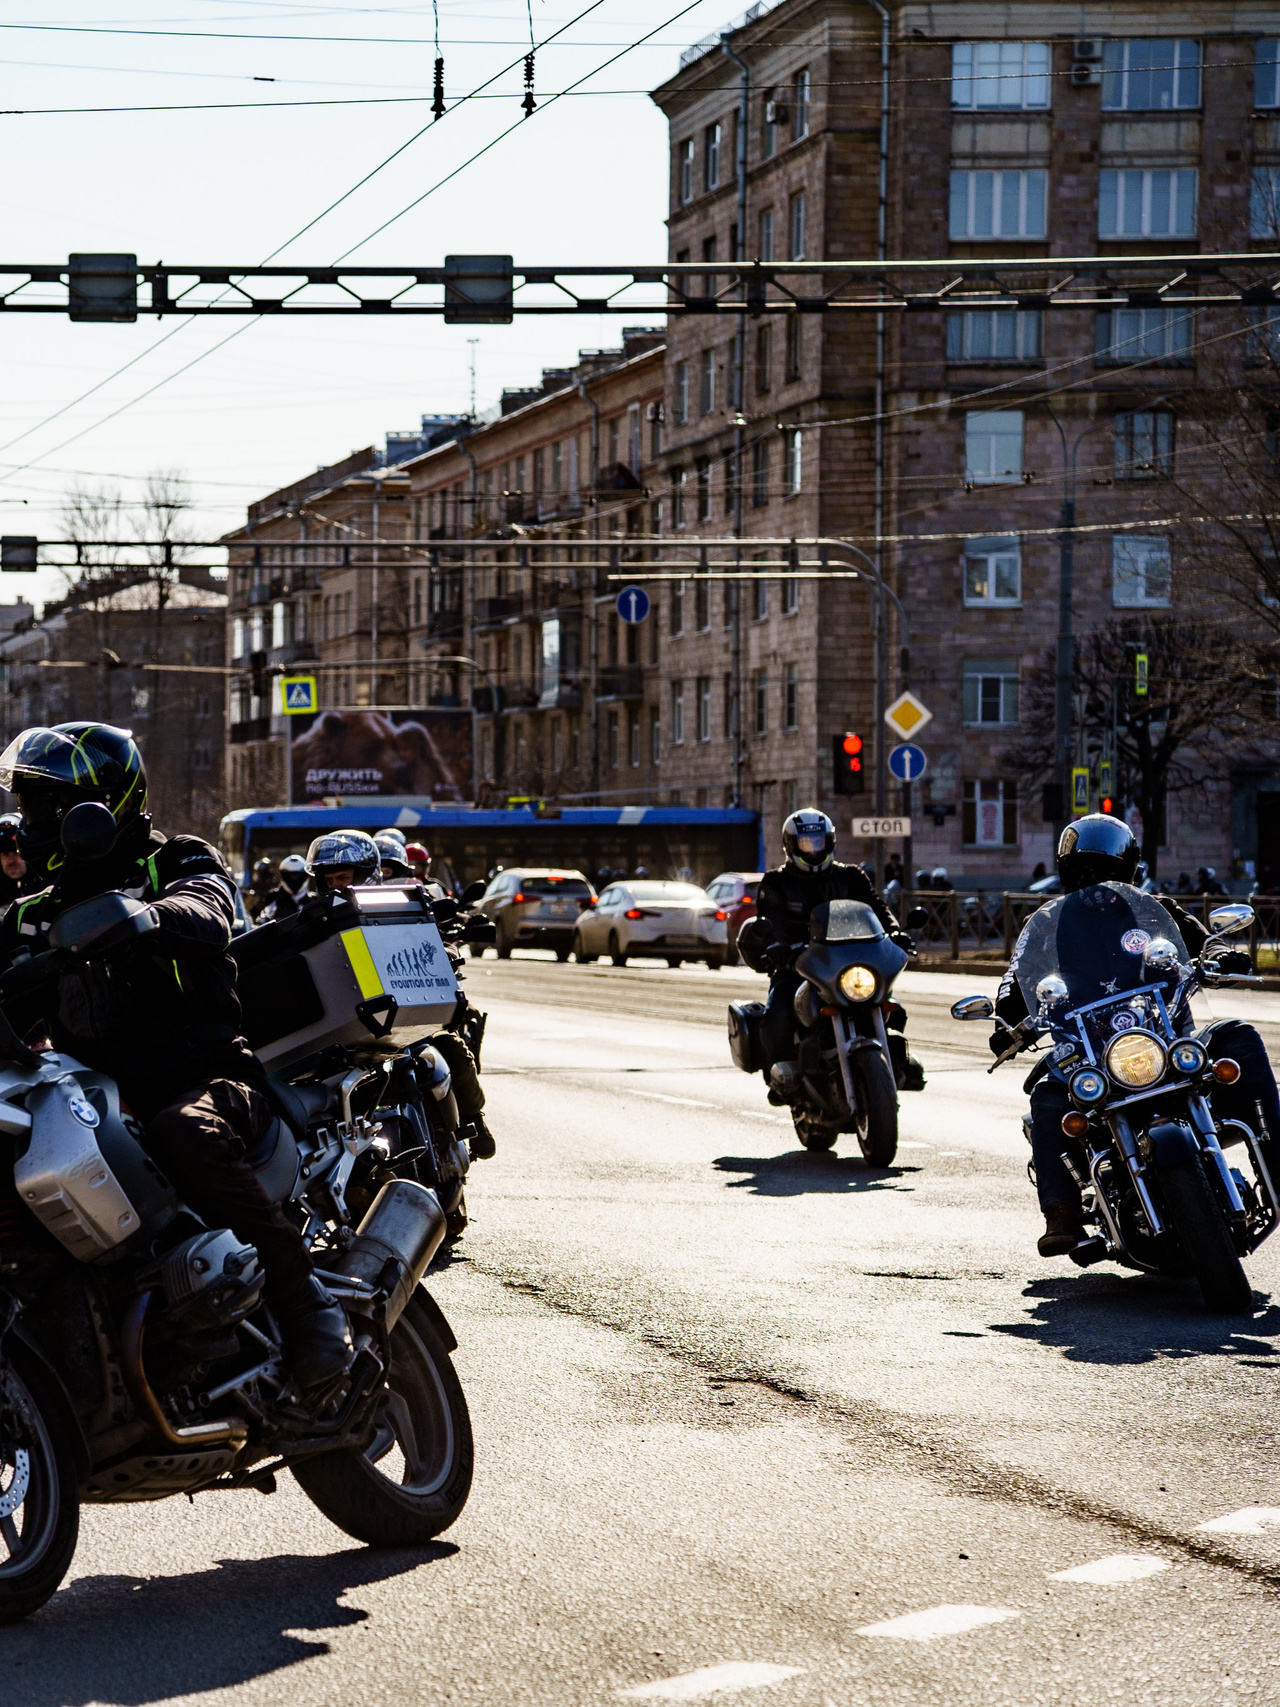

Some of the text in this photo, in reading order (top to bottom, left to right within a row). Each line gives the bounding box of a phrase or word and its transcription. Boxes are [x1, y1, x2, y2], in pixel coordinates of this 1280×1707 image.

[306, 768, 383, 782] ДРУЖИТЬ
[860, 821, 903, 834] СТОП
[390, 979, 425, 989] EVOLUTION
